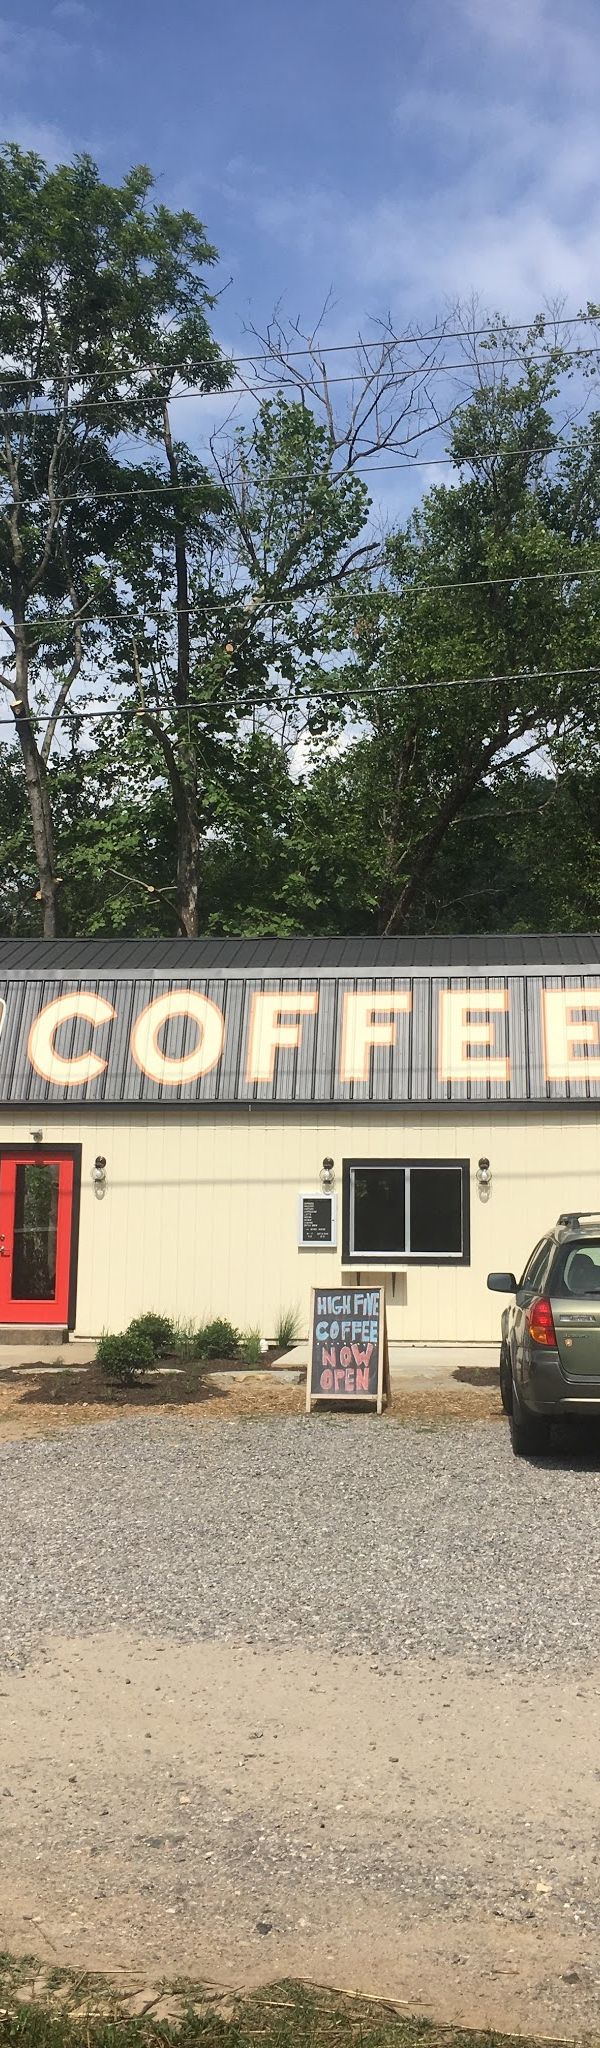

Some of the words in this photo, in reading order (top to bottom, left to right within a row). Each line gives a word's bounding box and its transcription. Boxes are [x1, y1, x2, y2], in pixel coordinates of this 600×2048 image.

[26, 989, 600, 1086] COFFEE
[317, 1294, 351, 1315] HIGH
[354, 1293, 380, 1316] FIVE
[316, 1320, 378, 1343] COFFEE
[322, 1343, 373, 1367] NOW
[320, 1368, 370, 1391] OPEN
